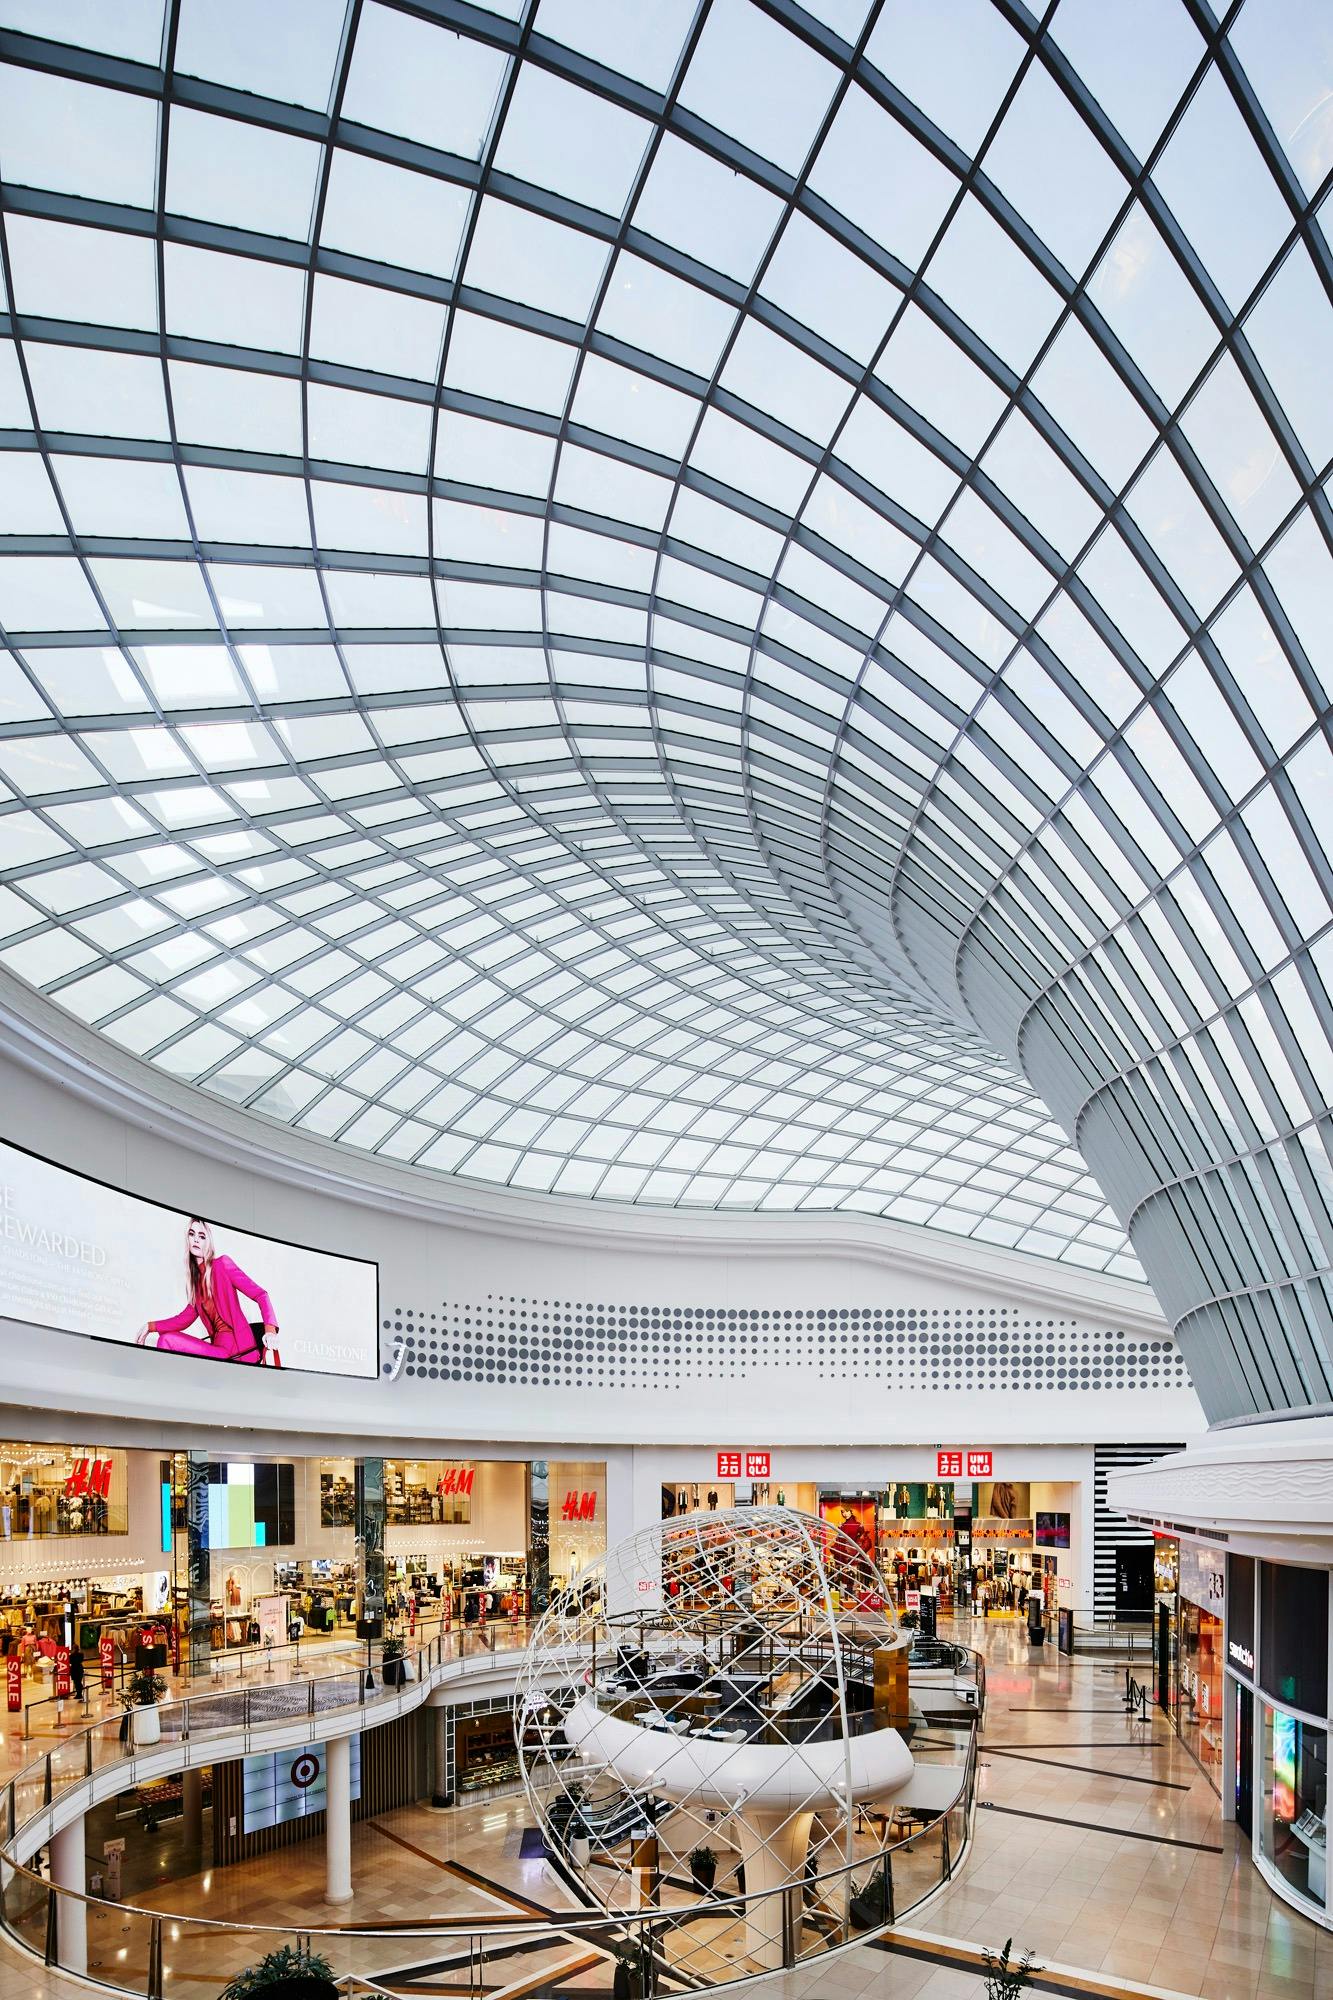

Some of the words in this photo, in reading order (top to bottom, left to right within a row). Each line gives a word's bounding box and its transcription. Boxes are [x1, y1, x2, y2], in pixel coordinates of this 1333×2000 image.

[294, 1339, 368, 1361] CHADSTONE
[64, 1458, 113, 1498] H&M
[438, 1468, 475, 1496] H&M
[562, 1490, 597, 1522] H&M
[7, 1661, 20, 1703] SALE
[57, 1651, 69, 1691] SALE
